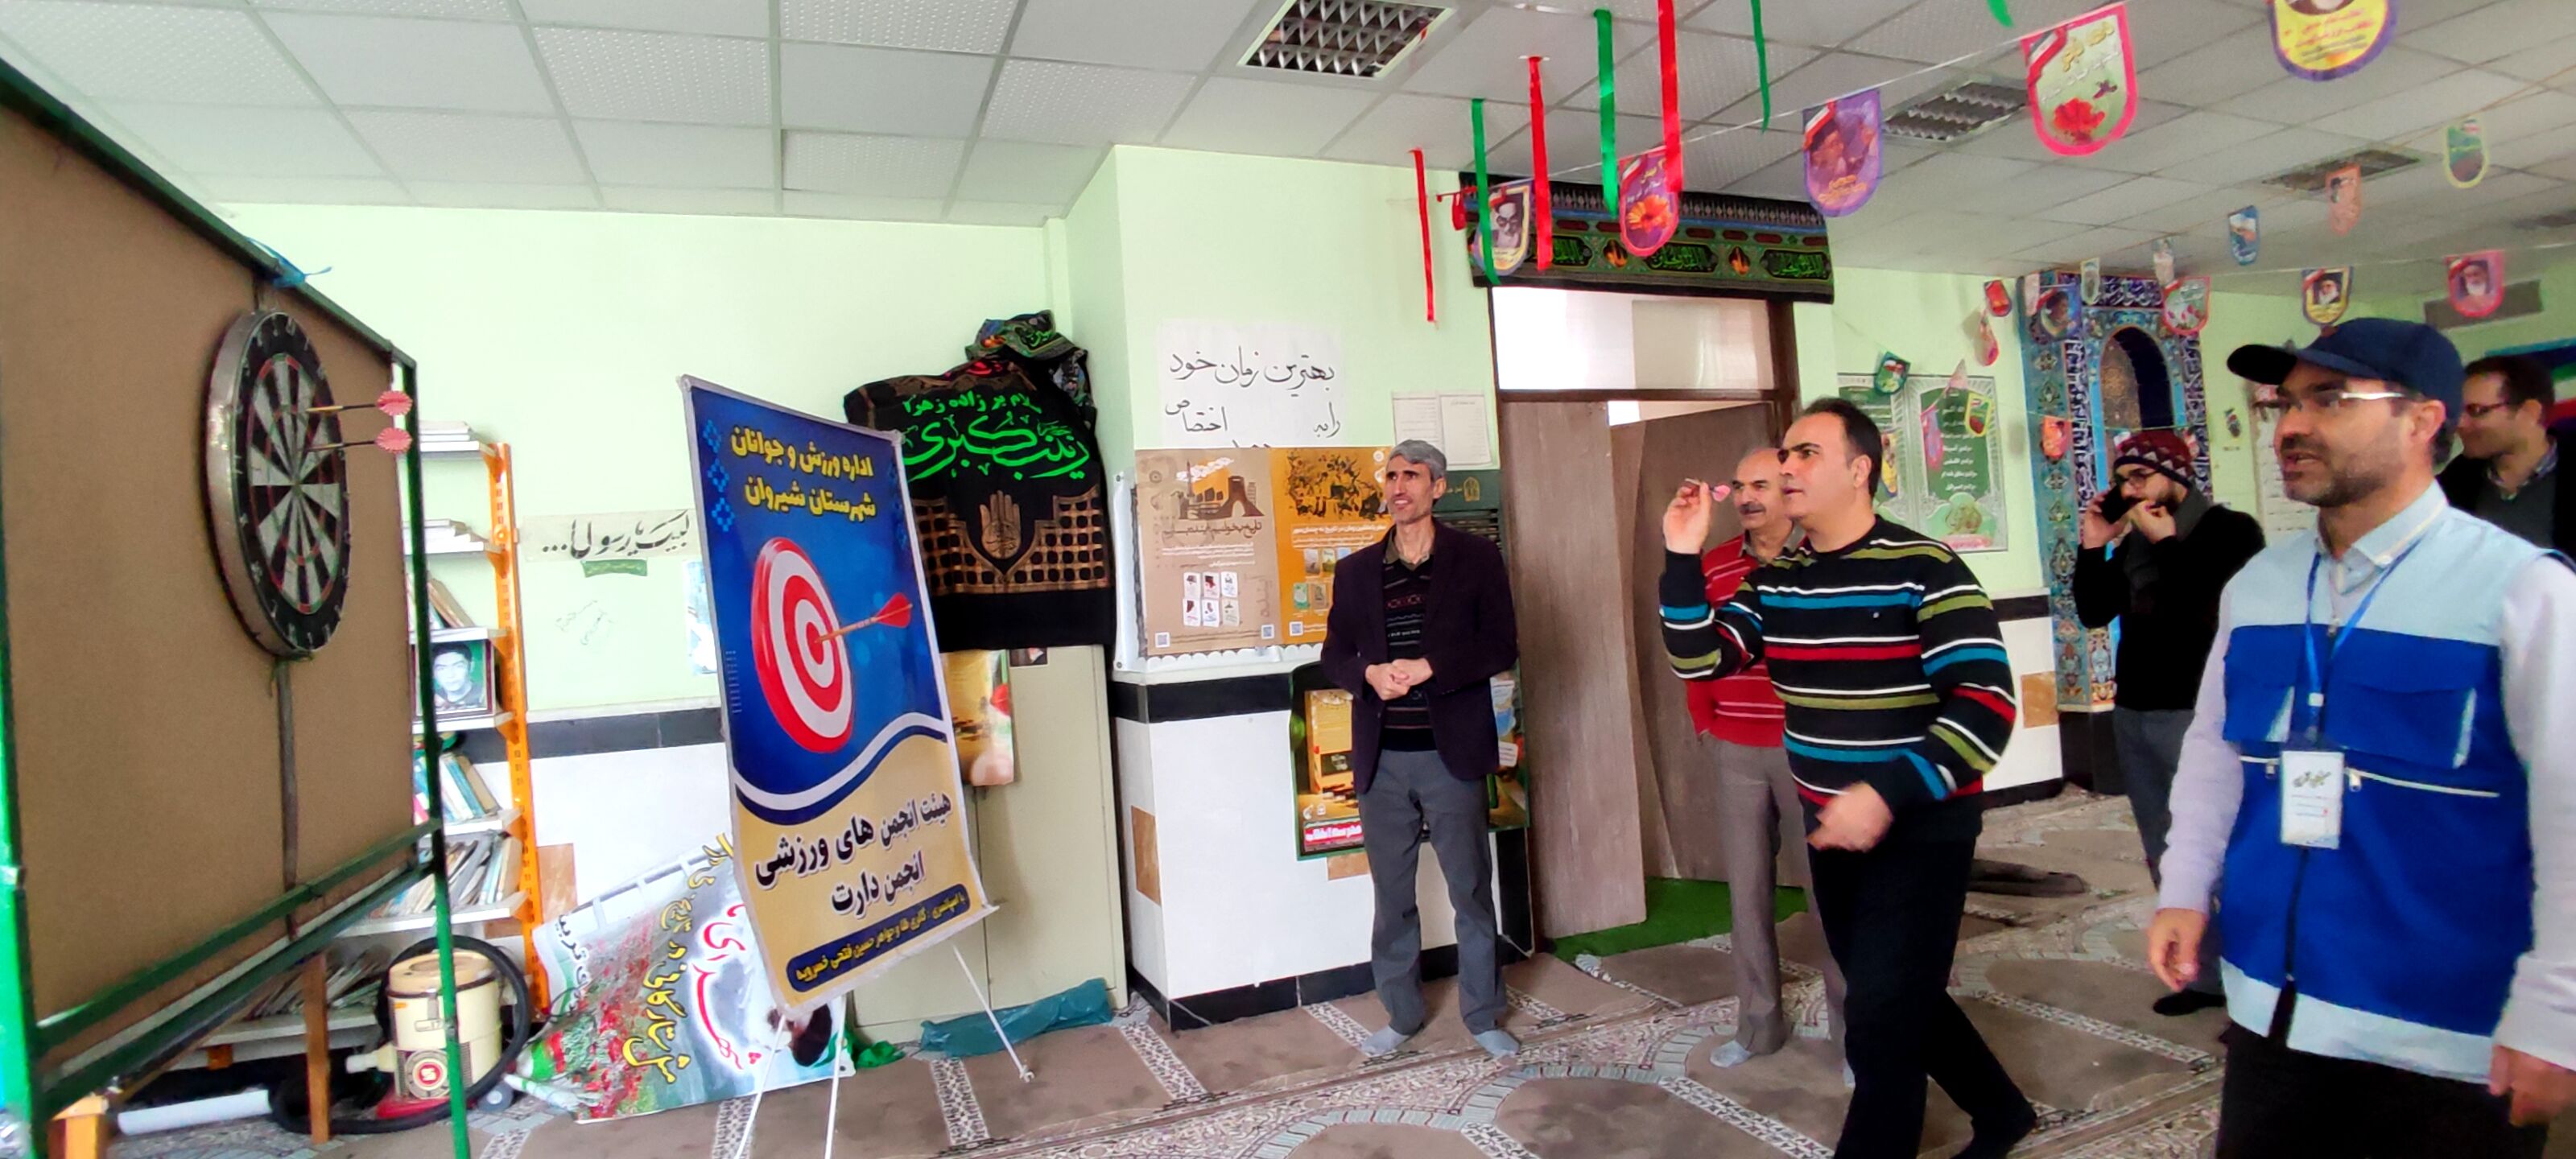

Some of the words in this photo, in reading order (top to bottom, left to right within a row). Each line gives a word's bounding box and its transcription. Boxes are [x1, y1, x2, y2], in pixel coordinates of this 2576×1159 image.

[1170, 351, 1217, 380] خود
[1215, 345, 1260, 388] زمان
[1264, 354, 1335, 397] بهترین
[1165, 398, 1228, 432] اختصاص
[730, 425, 785, 468] جوانان
[787, 448, 796, 469] و
[799, 443, 840, 478] ورزش
[841, 453, 873, 482] اداره
[745, 476, 806, 514] شیروان
[809, 487, 877, 523] شهرستان
[881, 799, 919, 846] انجمن
[919, 792, 952, 826] هیئت
[835, 815, 874, 860] های
[755, 834, 830, 886] ورزشی
[885, 850, 925, 902] انجمن
[831, 870, 879, 916] دارت
[622, 1037, 691, 1083] مثل
